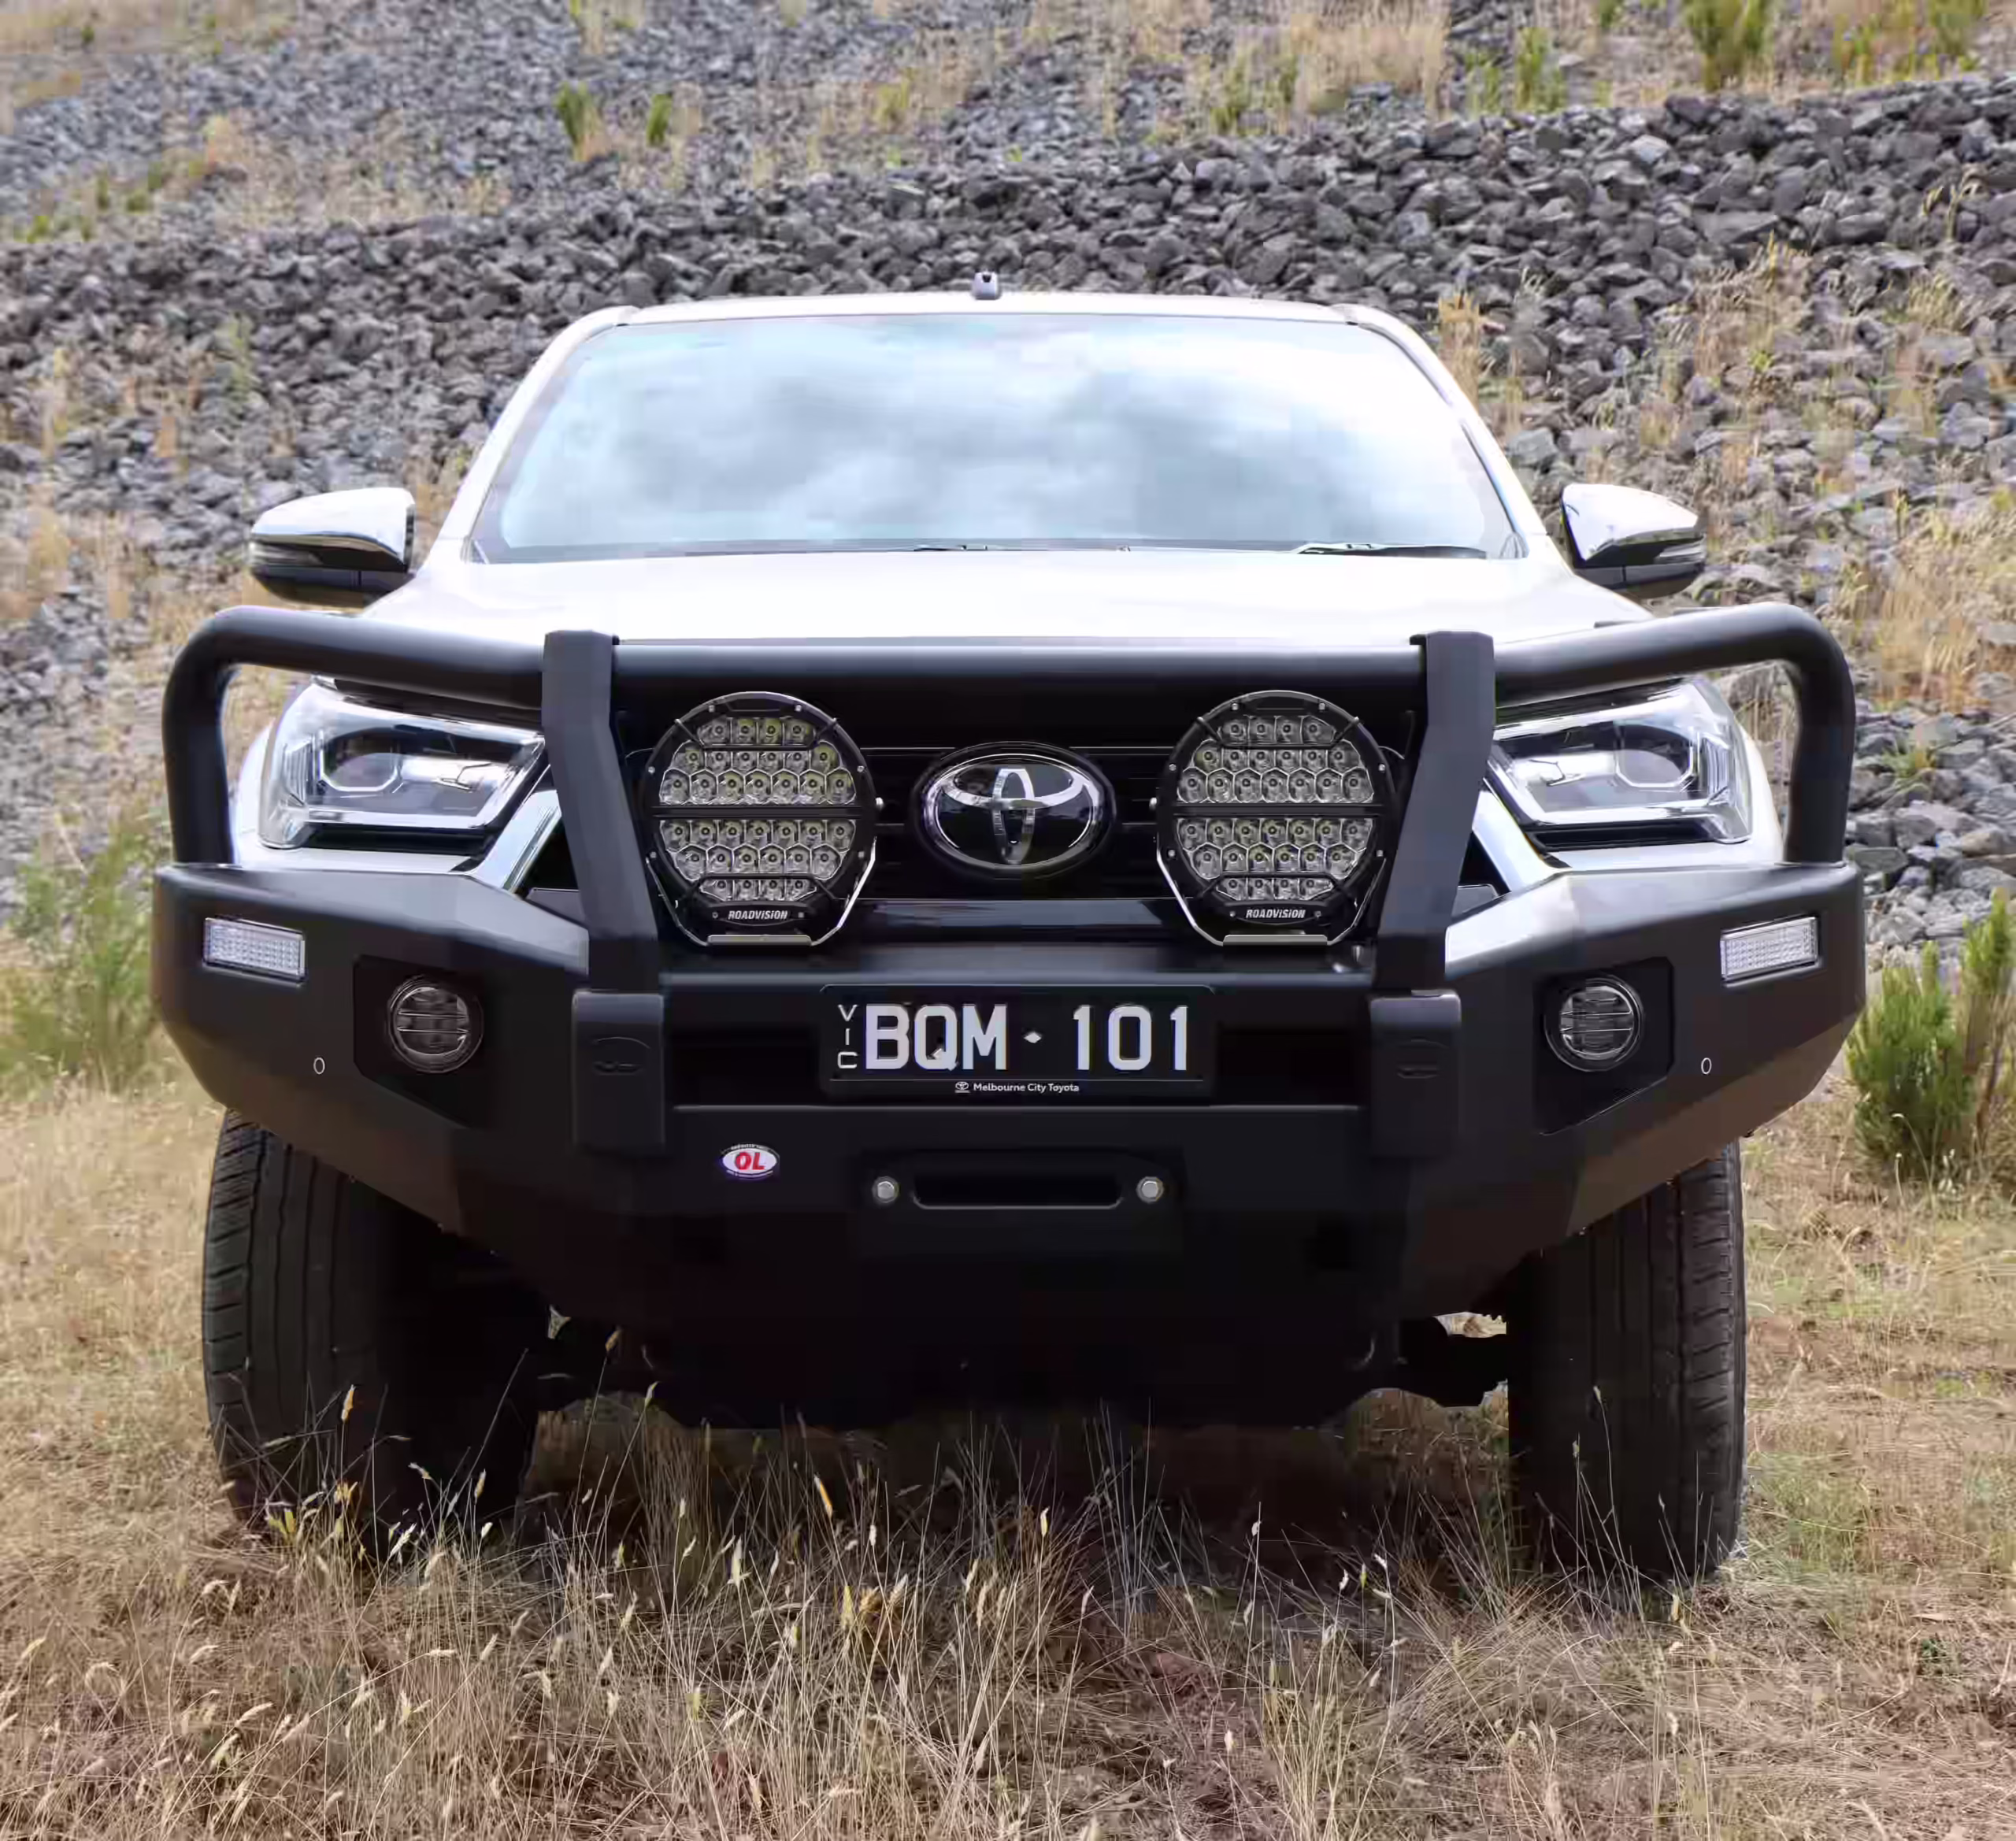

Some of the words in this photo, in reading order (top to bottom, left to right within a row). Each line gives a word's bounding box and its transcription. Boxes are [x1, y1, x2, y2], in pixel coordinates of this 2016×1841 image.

[837, 1004, 858, 1069] VIC
[865, 1004, 1007, 1070] BQM
[1073, 1005, 1188, 1071] 101
[973, 1083, 1025, 1091] Melbourne
[1027, 1083, 1047, 1094] City
[1048, 1083, 1080, 1093] Toyota
[735, 1151, 765, 1170] OL
